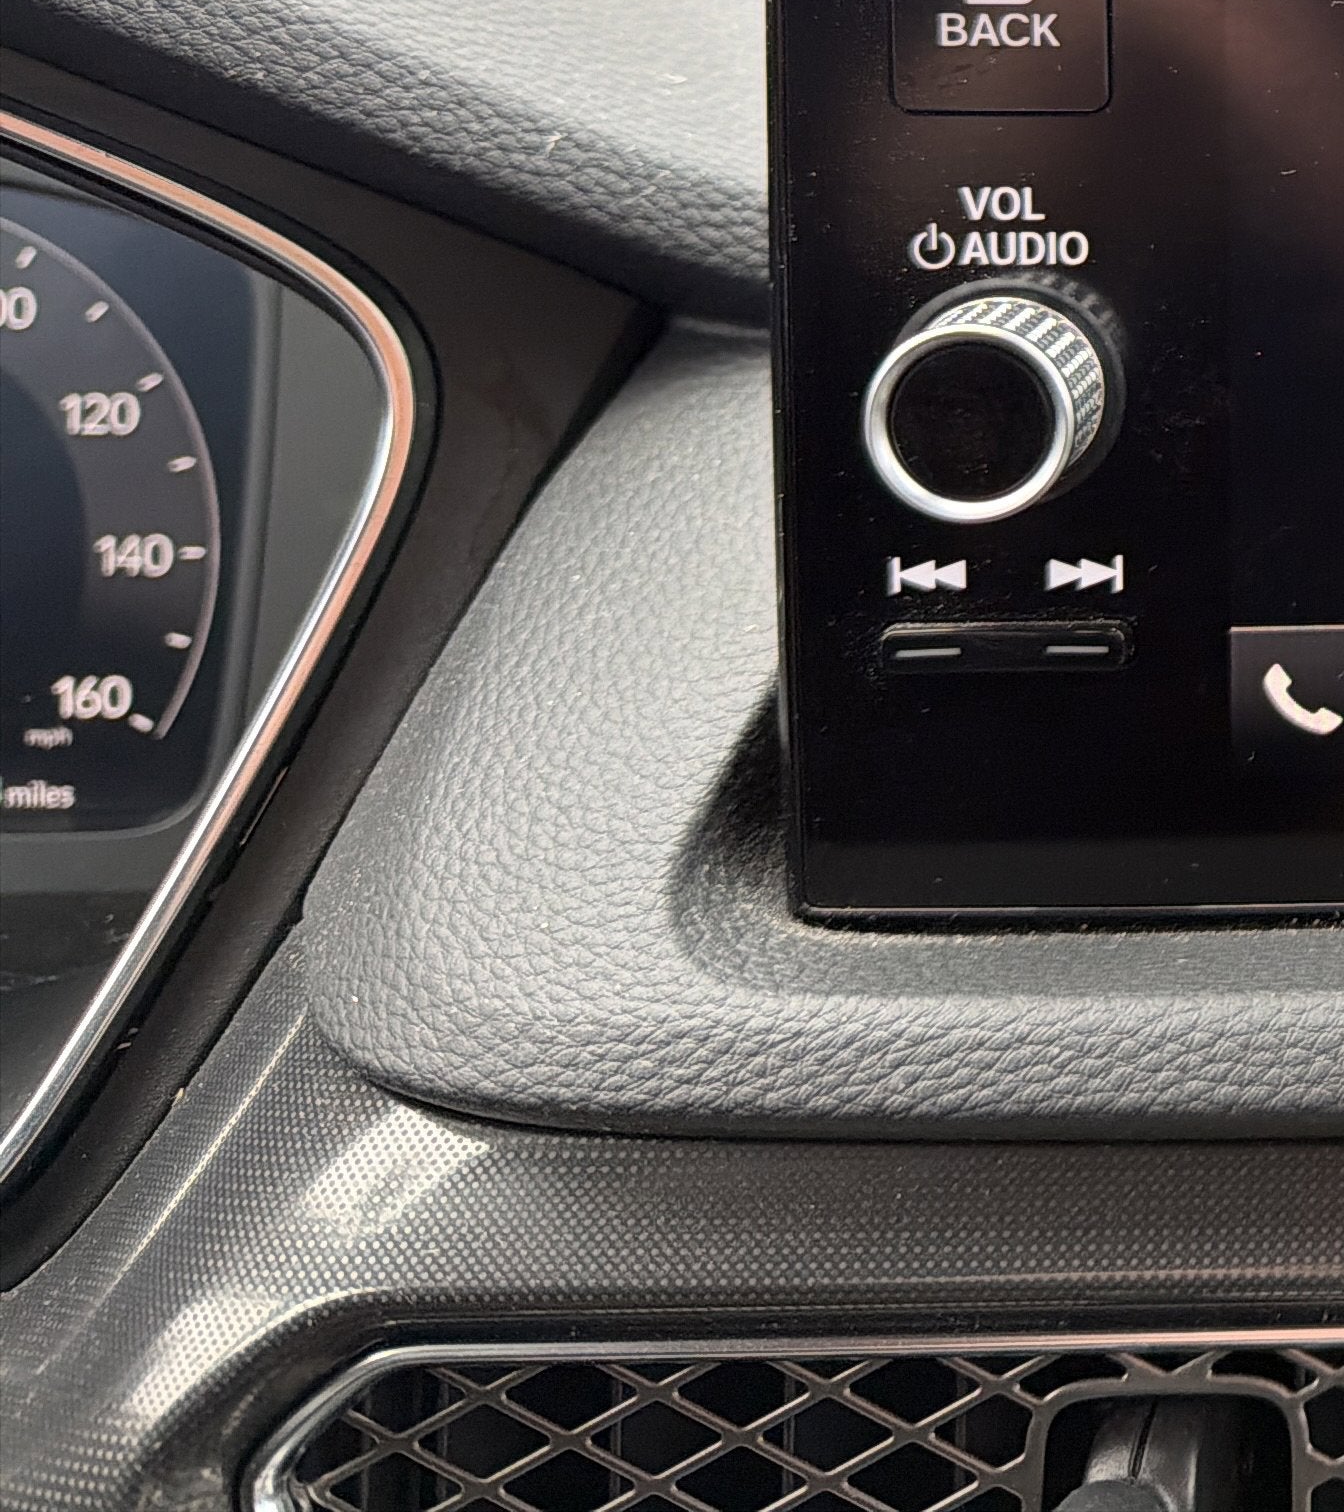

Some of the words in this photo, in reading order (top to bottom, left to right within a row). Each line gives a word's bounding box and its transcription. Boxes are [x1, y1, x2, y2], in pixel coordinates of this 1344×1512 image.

[938, 12, 1061, 47] BACK
[958, 186, 1046, 221] VOL
[958, 230, 1089, 266] AUDIO
[0, 286, 38, 331] 0
[59, 391, 141, 436] 120
[94, 533, 175, 578] 140
[51, 674, 133, 720] 160
[4, 779, 75, 809] miles
